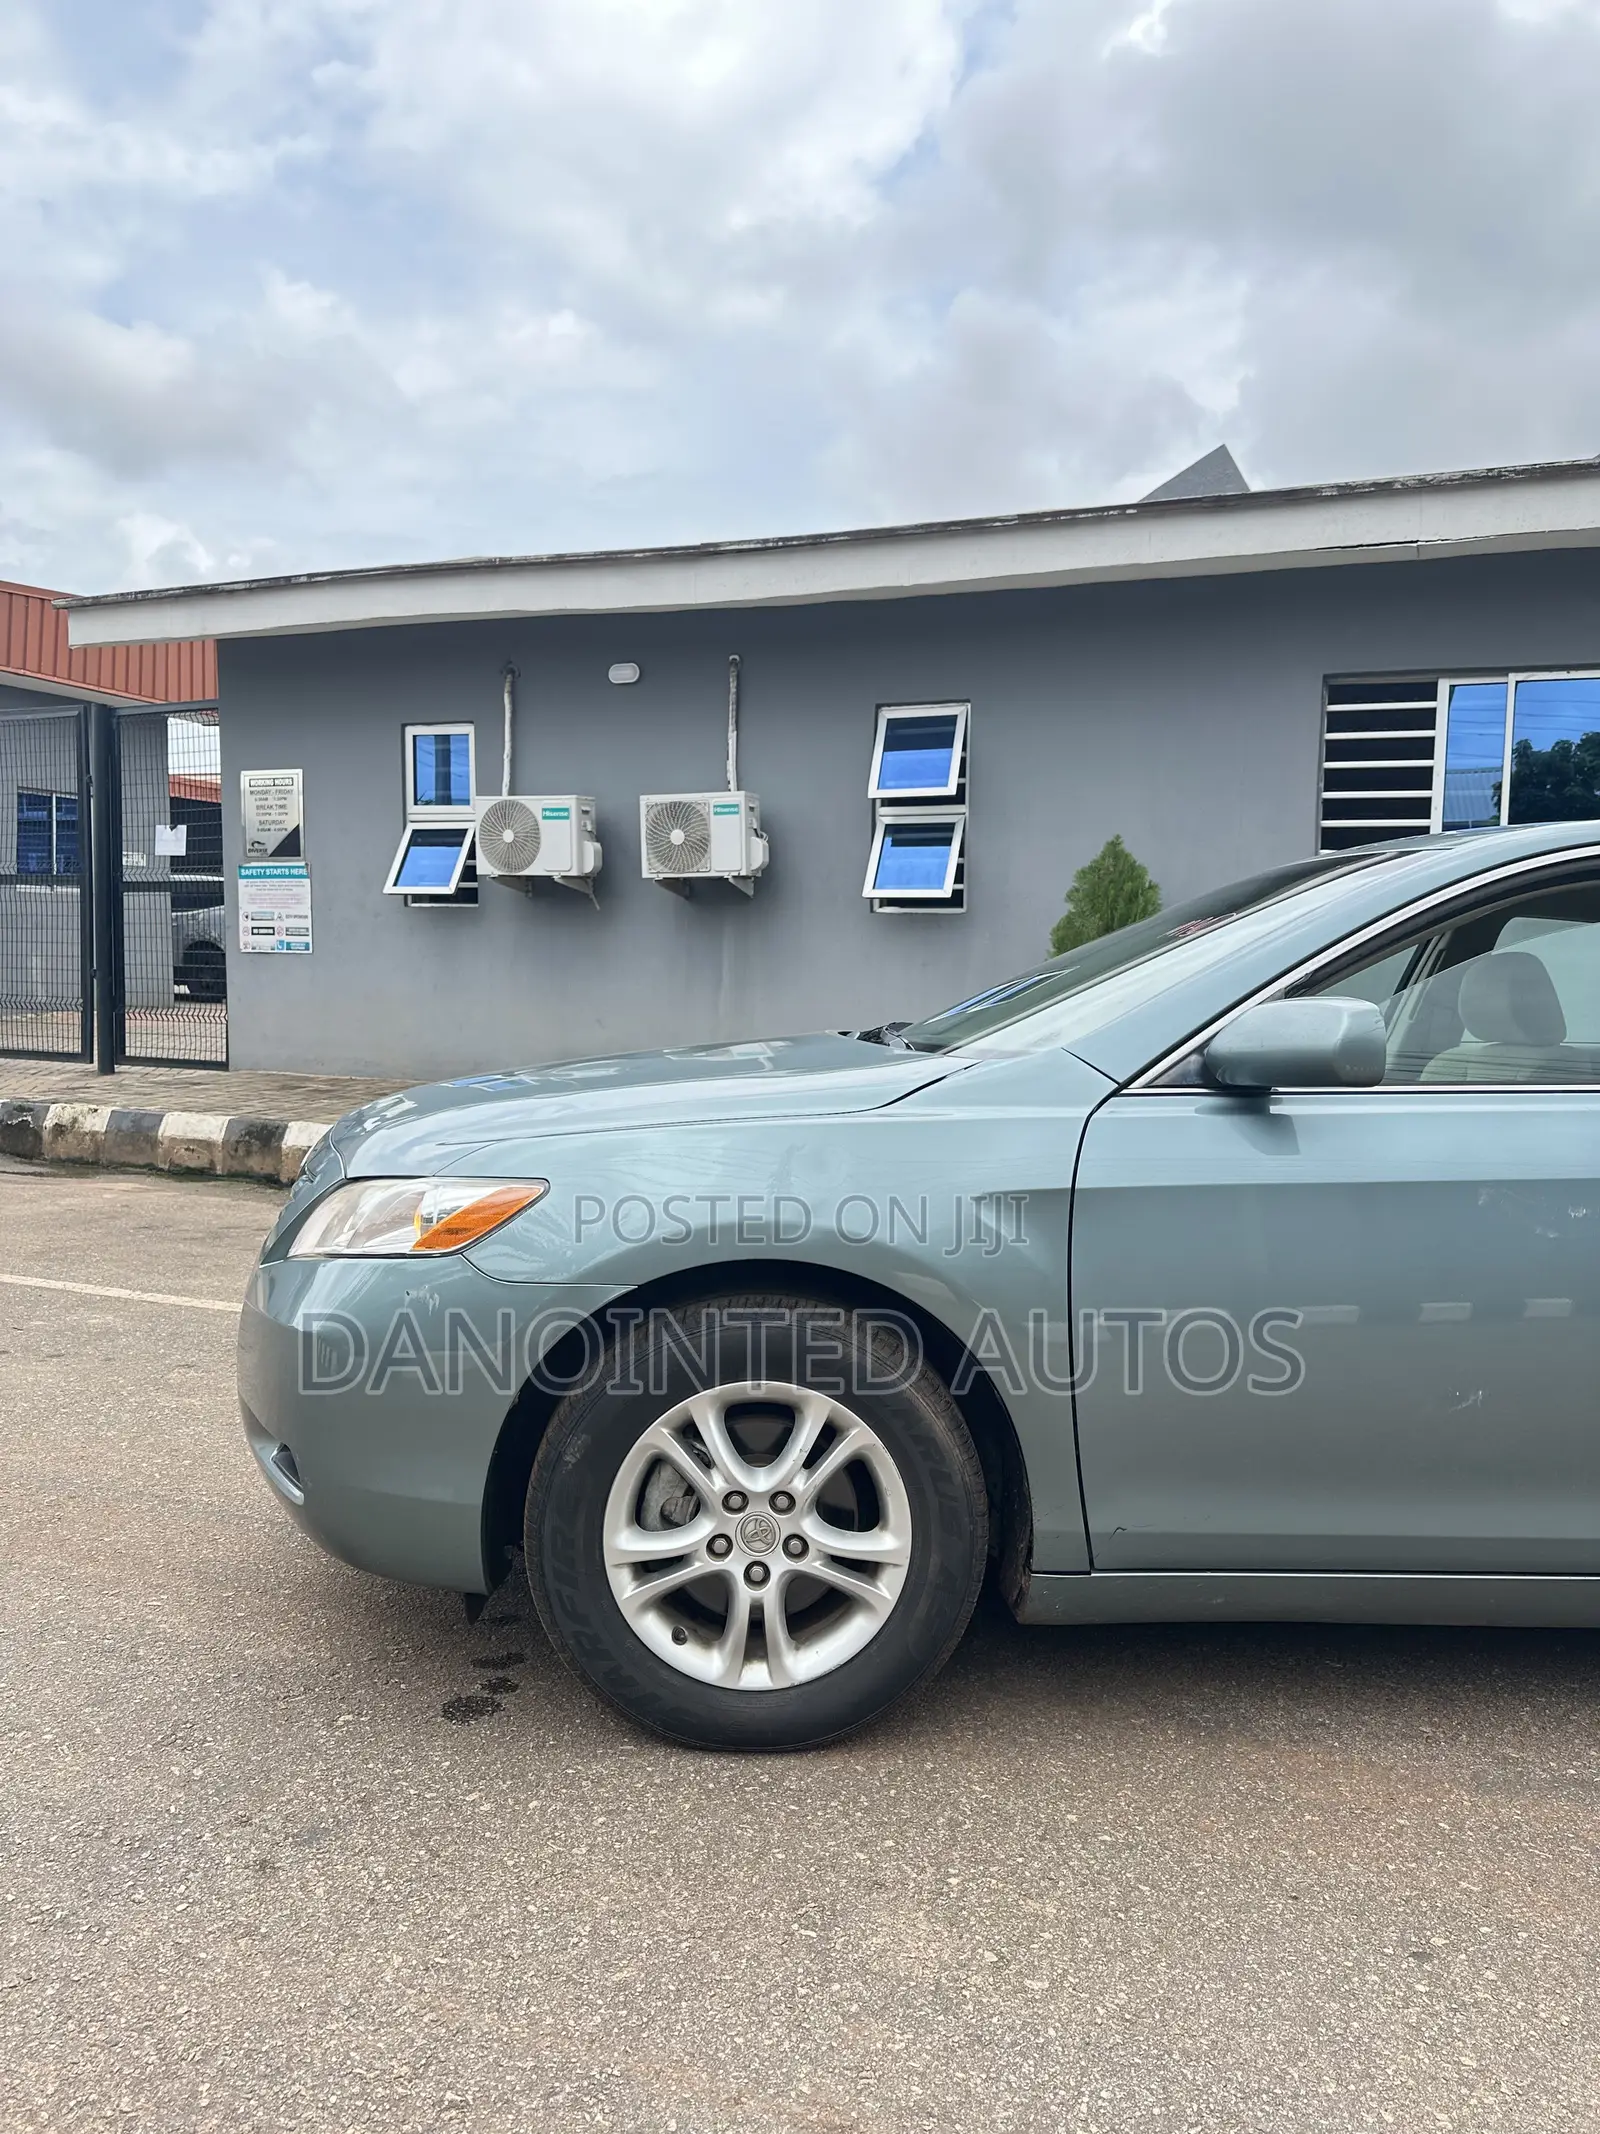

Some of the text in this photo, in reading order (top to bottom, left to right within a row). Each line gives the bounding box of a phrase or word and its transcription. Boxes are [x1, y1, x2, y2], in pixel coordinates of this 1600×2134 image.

[542, 810, 569, 818] Hisense
[714, 806, 740, 814] Hisense
[240, 867, 308, 876] SAFETY STARTS HERE
